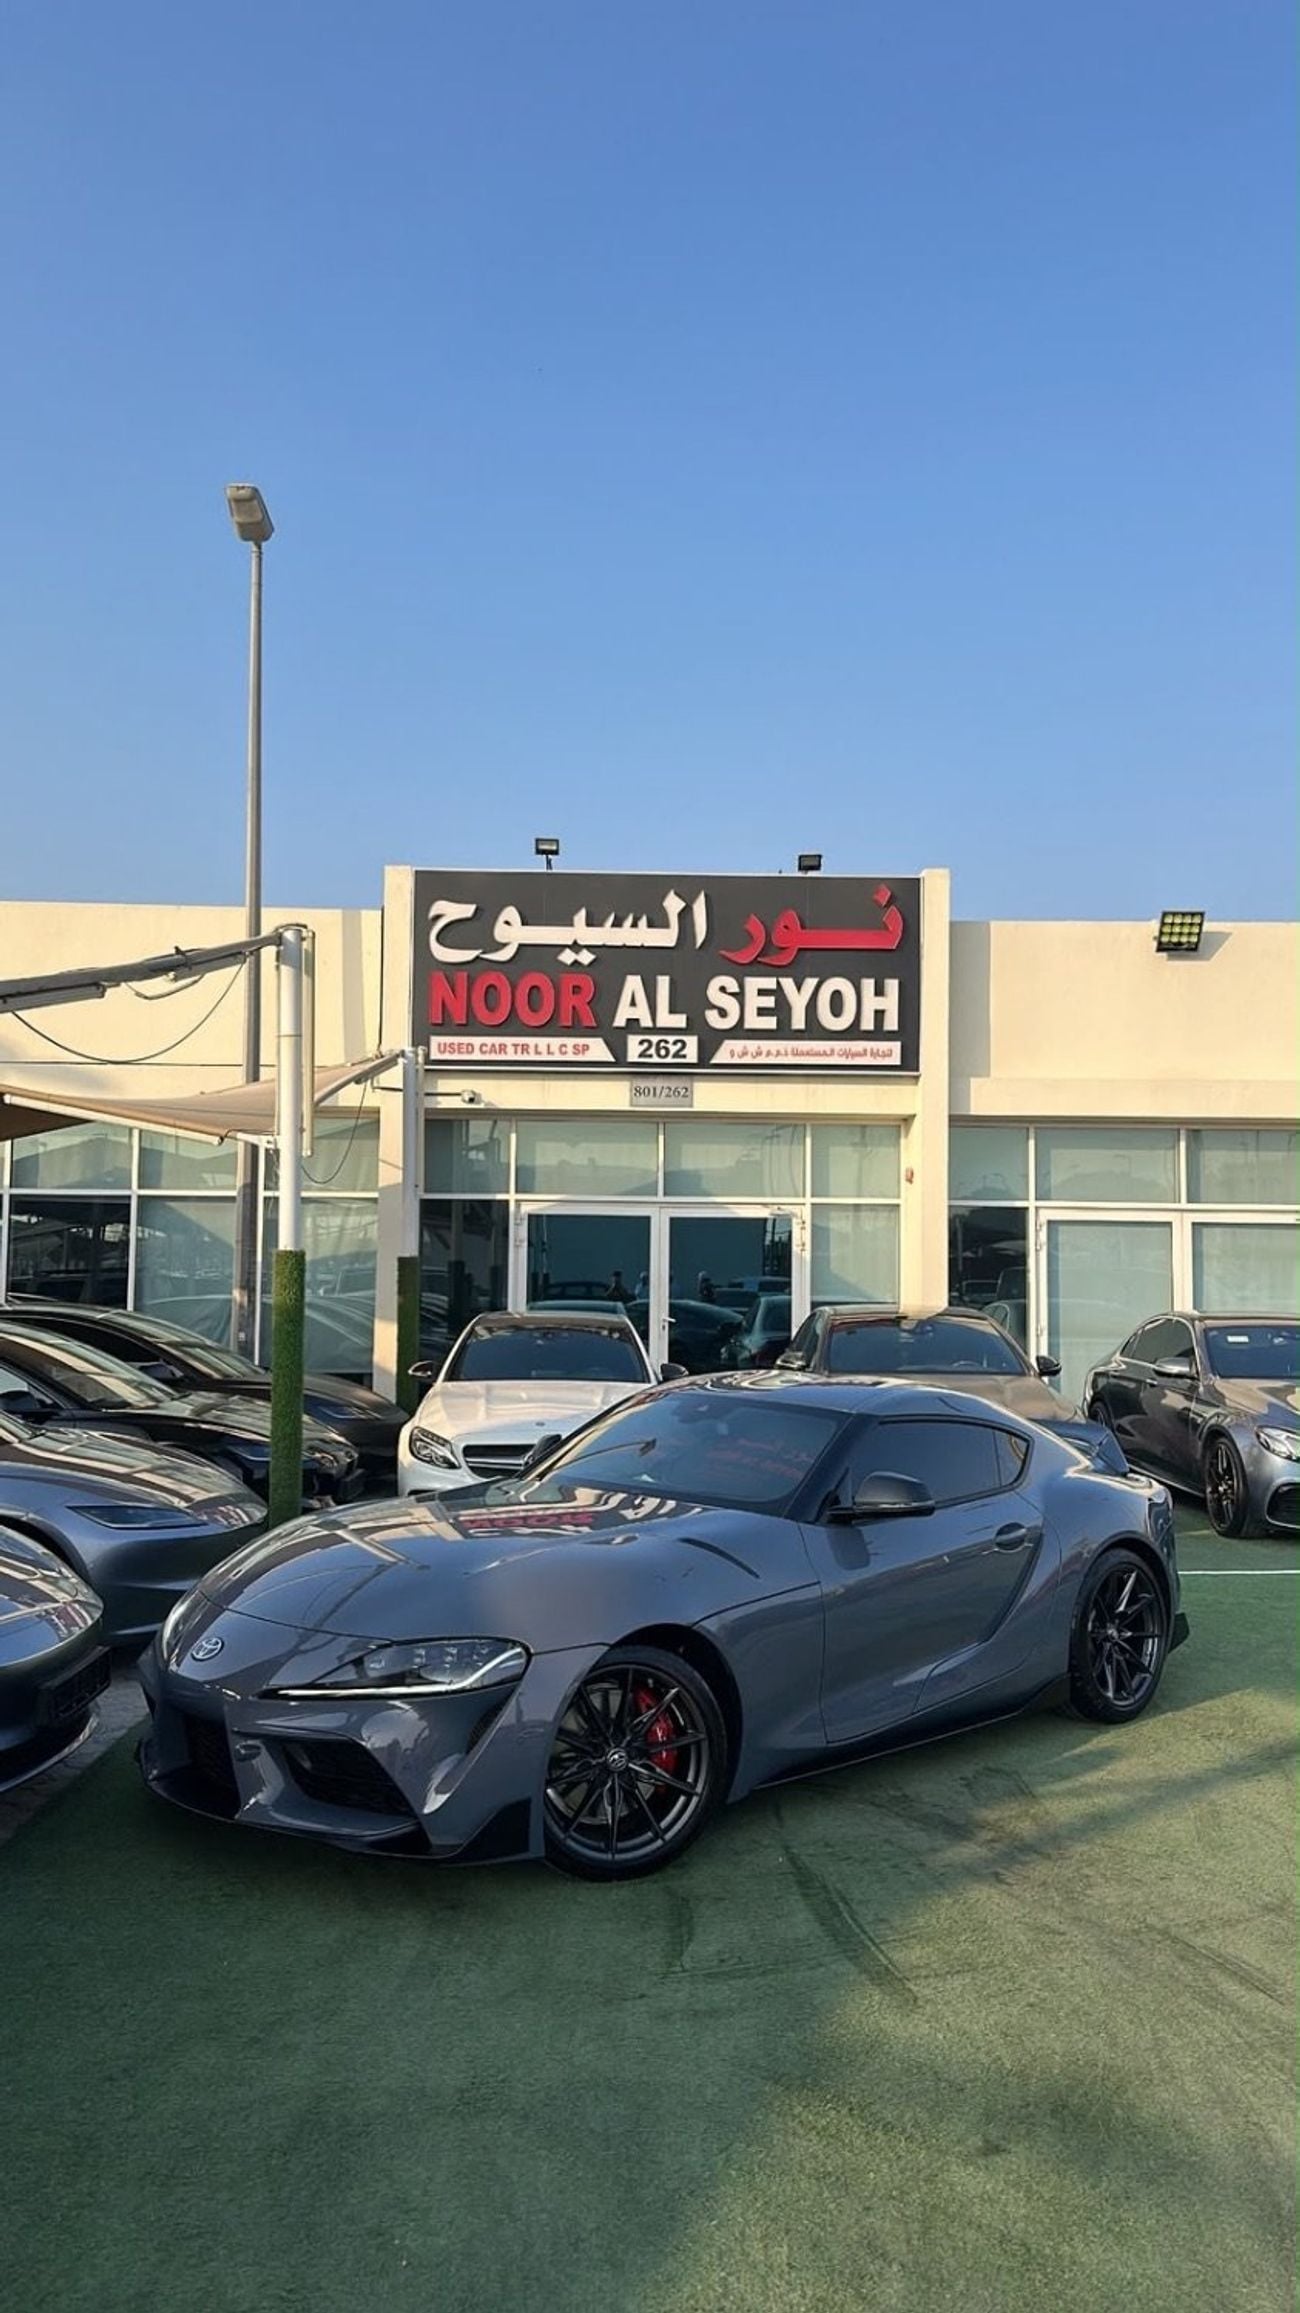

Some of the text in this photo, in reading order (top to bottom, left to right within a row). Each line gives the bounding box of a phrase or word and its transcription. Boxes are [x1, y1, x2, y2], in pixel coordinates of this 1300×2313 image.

[428, 883, 904, 966] نور السيوح
[428, 970, 900, 1032] NOOR AL SEYOH
[437, 1042, 590, 1056] USED CAR TR L L C SP
[637, 1038, 688, 1060] 262
[633, 1085, 690, 1099] 801/262
